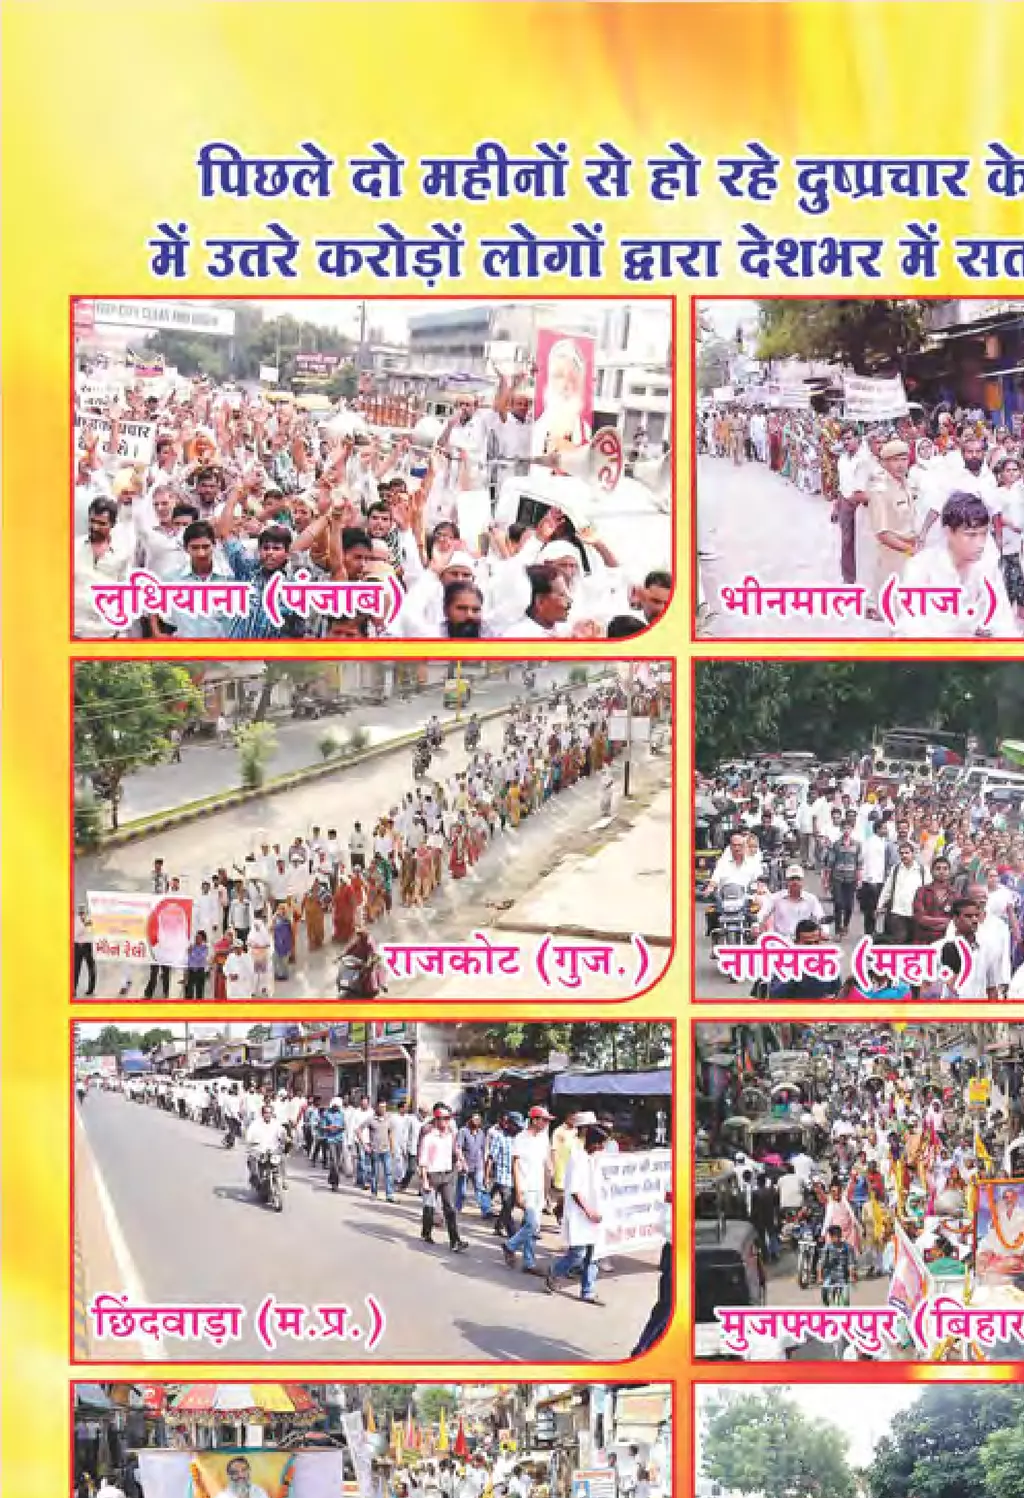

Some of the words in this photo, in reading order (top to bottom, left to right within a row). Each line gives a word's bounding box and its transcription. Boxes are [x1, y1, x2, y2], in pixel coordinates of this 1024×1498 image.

[199, 143, 332, 197] पिछले
[351, 143, 404, 197] दो
[421, 143, 568, 200] महीनों
[586, 143, 631, 197] से
[648, 143, 700, 200] हो
[718, 143, 779, 200] रहे
[797, 161, 969, 212] दुष्प्रचार
[150, 223, 189, 277] में
[206, 224, 299, 277] उतरे
[317, 223, 464, 287] करोड़ों
[481, 223, 604, 277] लोगों
[621, 242, 721, 281] द्वारा
[739, 223, 882, 277] देशभर
[900, 224, 939, 277] में
